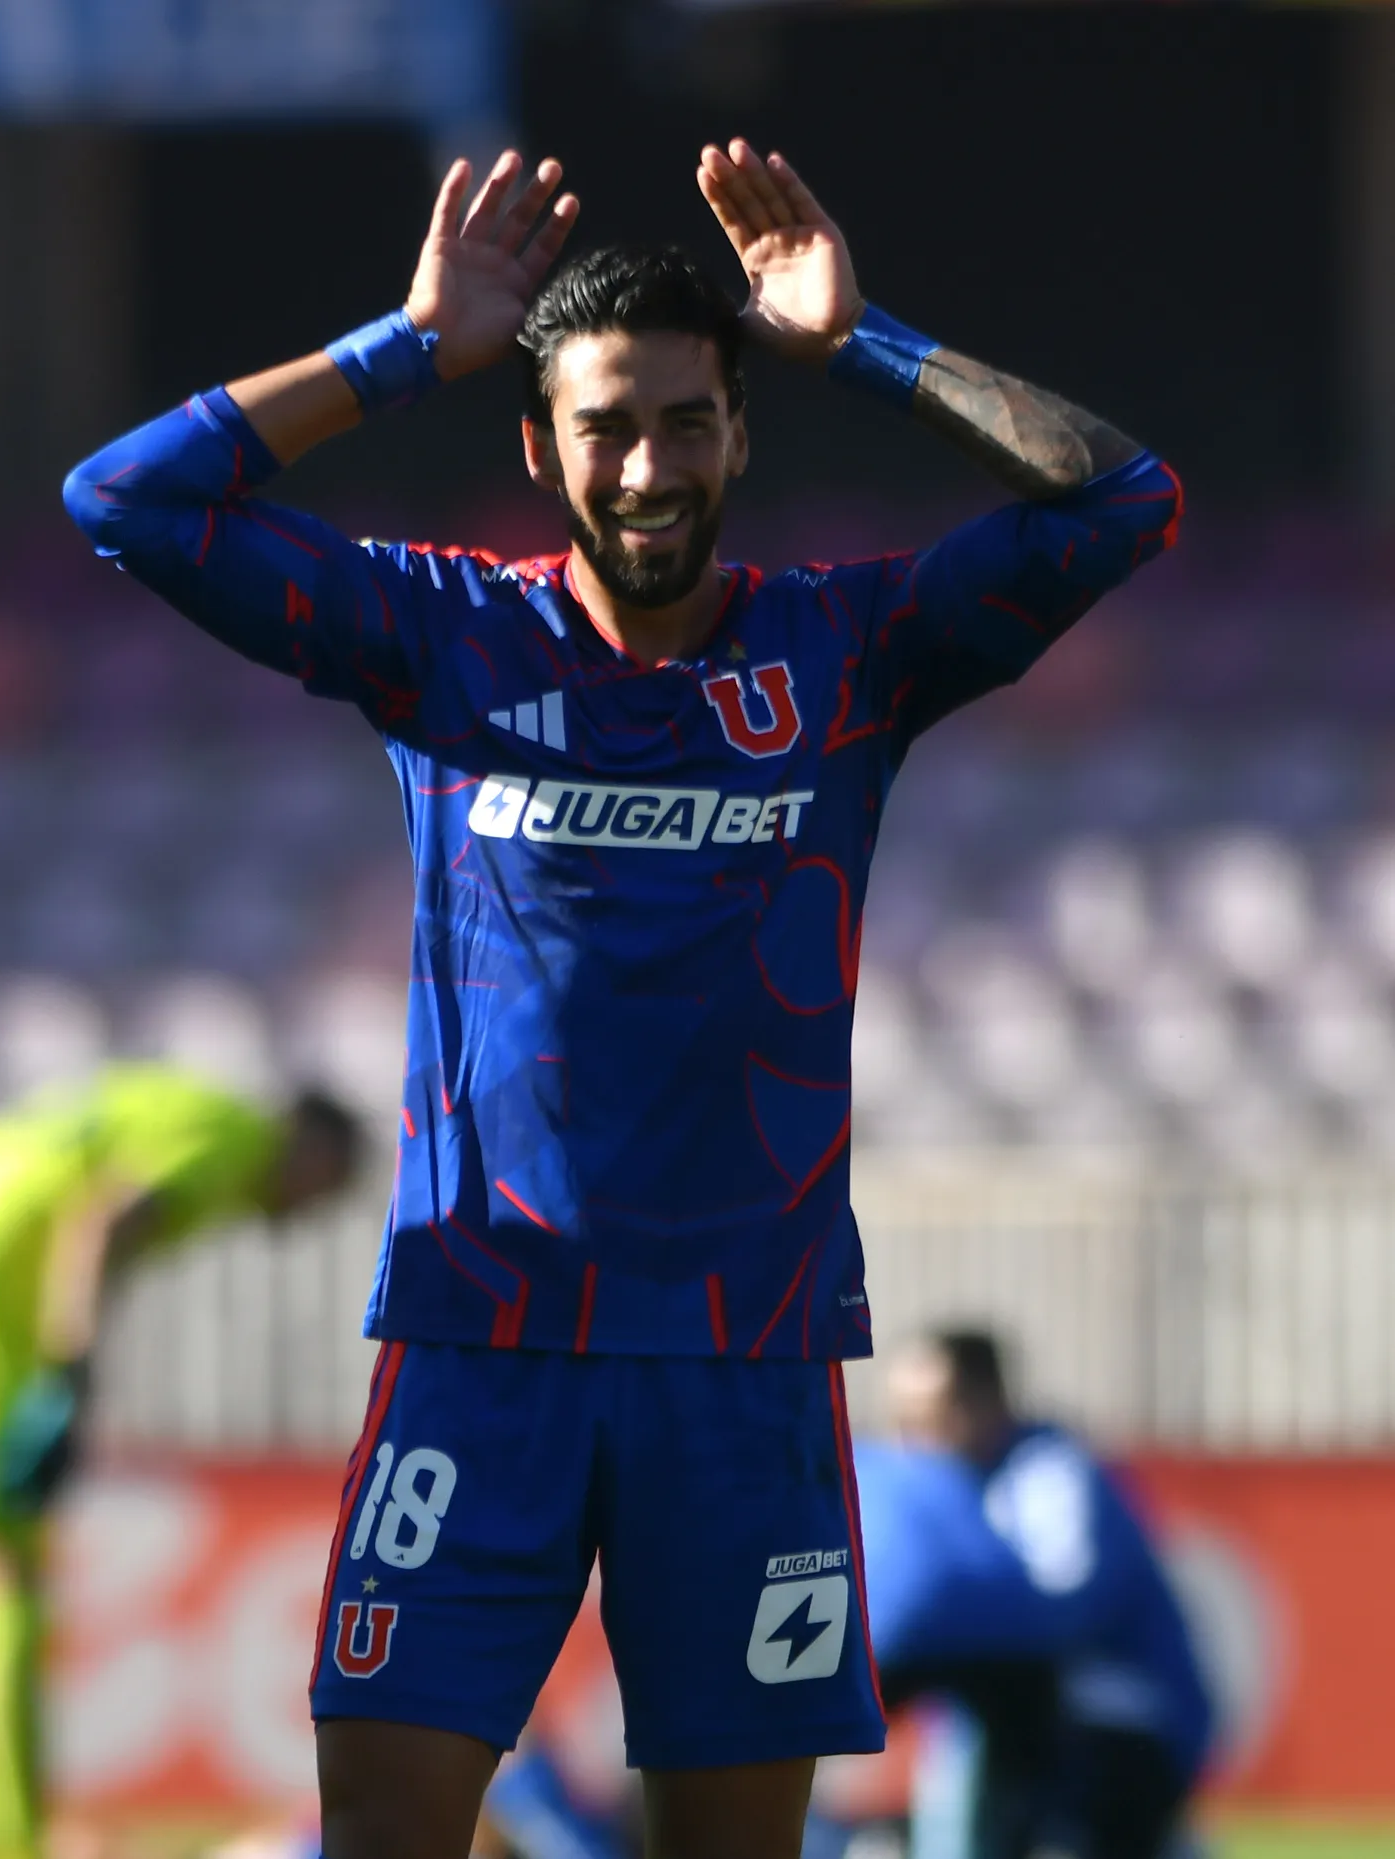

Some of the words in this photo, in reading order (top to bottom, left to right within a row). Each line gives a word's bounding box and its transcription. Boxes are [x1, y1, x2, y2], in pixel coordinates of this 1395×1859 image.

[701, 661, 802, 759] U
[350, 1442, 457, 1569] 18
[333, 1602, 399, 1679] U
